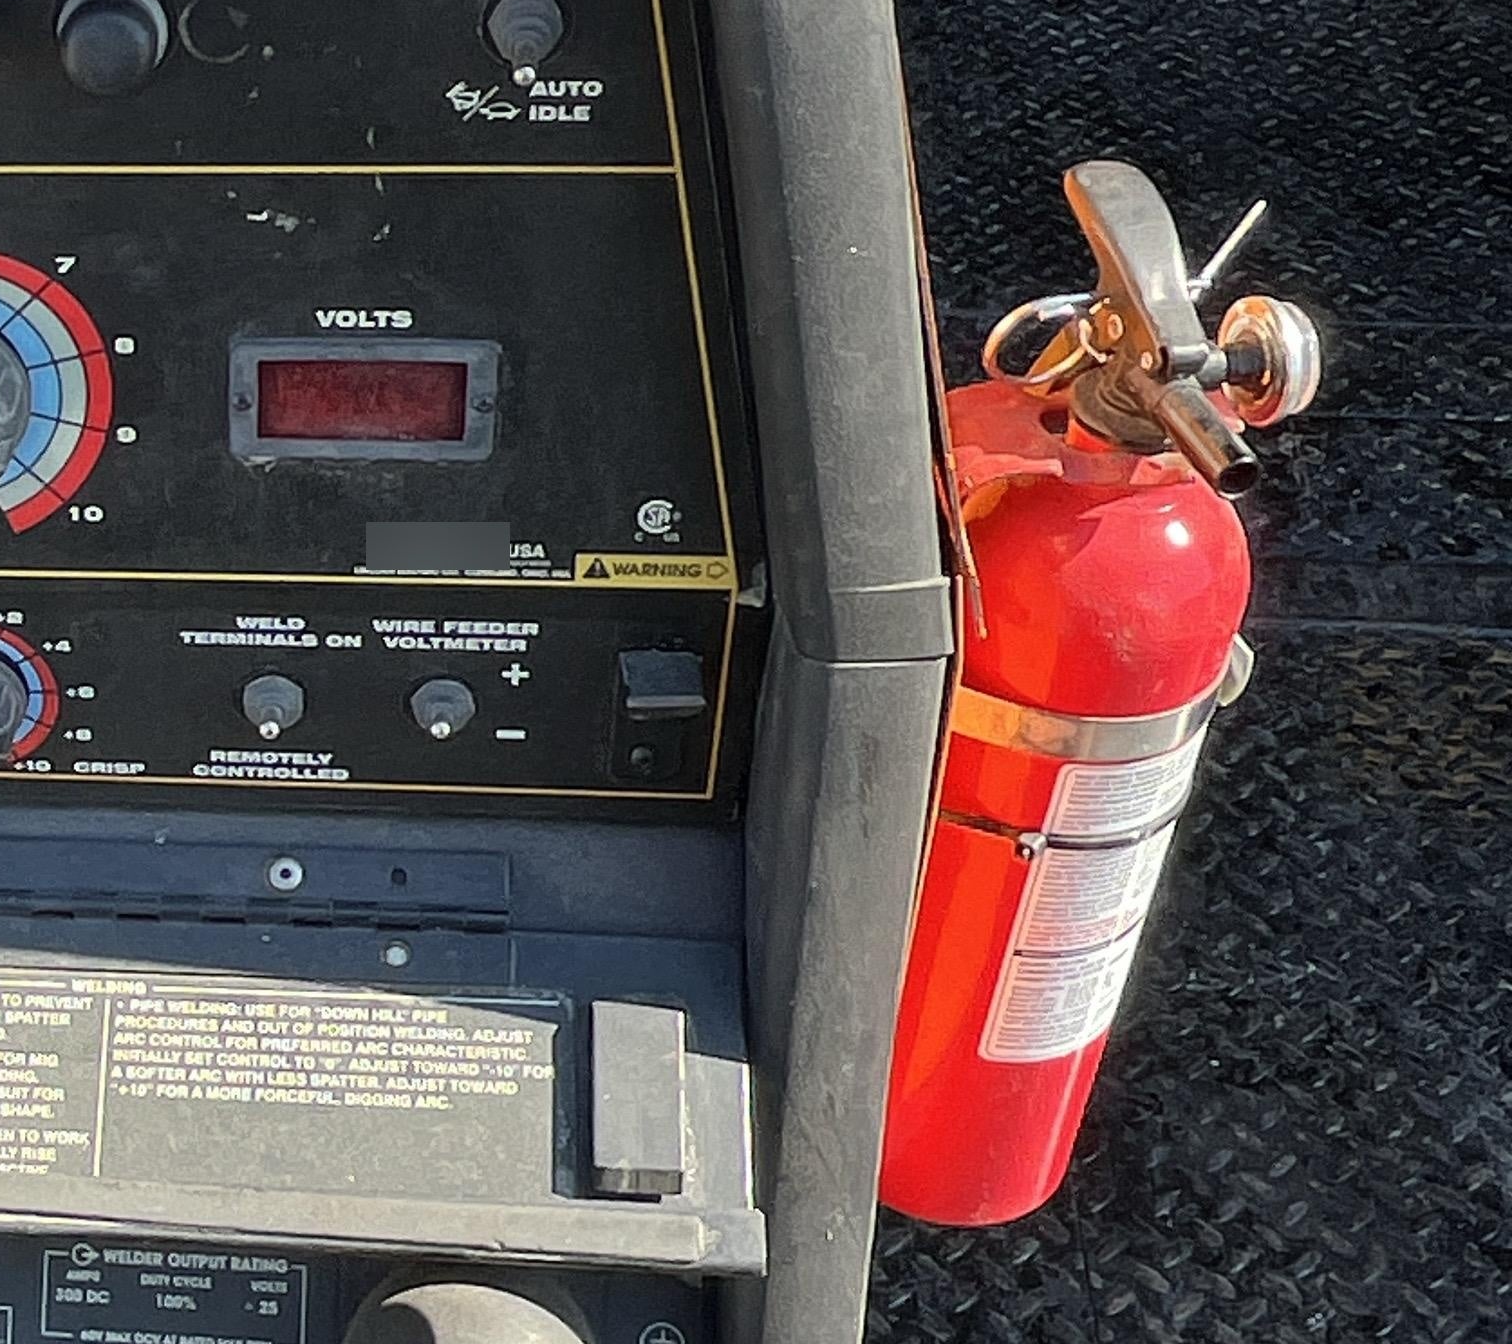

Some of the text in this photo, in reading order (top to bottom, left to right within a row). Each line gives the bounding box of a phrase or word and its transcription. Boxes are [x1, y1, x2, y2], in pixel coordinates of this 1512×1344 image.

[529, 81, 604, 97] AUTO
[528, 104, 591, 122] IDLE
[54, 256, 76, 274] 7
[315, 310, 413, 328] VOLTS
[68, 505, 104, 522] 10
[612, 562, 703, 578] WARNING
[236, 616, 306, 631] WELD
[372, 619, 539, 636] WIRE FEEDER
[179, 631, 362, 648] TERMINALS ON
[382, 636, 527, 651] VOLTMETER
[210, 750, 333, 766] REMOTELY
[72, 760, 146, 775] CRISP
[192, 763, 350, 782] CONTROLLED
[72, 979, 146, 994] WELDING
[5, 1010, 70, 1026] SPATTER
[129, 998, 446, 1023] PIPE USE FOR PIPE
[114, 1014, 533, 1044] PROCEDURES AND OUT OF POSITION ADJUST
[113, 1031, 388, 1055] ARC CONTROL FOR PREFERRED ARC
[112, 1048, 553, 1079] INITIALLY SET CONTROL TO ADJUST TOWARD FOR
[111, 1065, 518, 1095] A SOFTER ARC WITH LESS ADJUST TOWARD
[156, 1083, 411, 1107] FOR A MORE DIGGING
[103, 1248, 287, 1273] WELDER OUTPUT RATING
